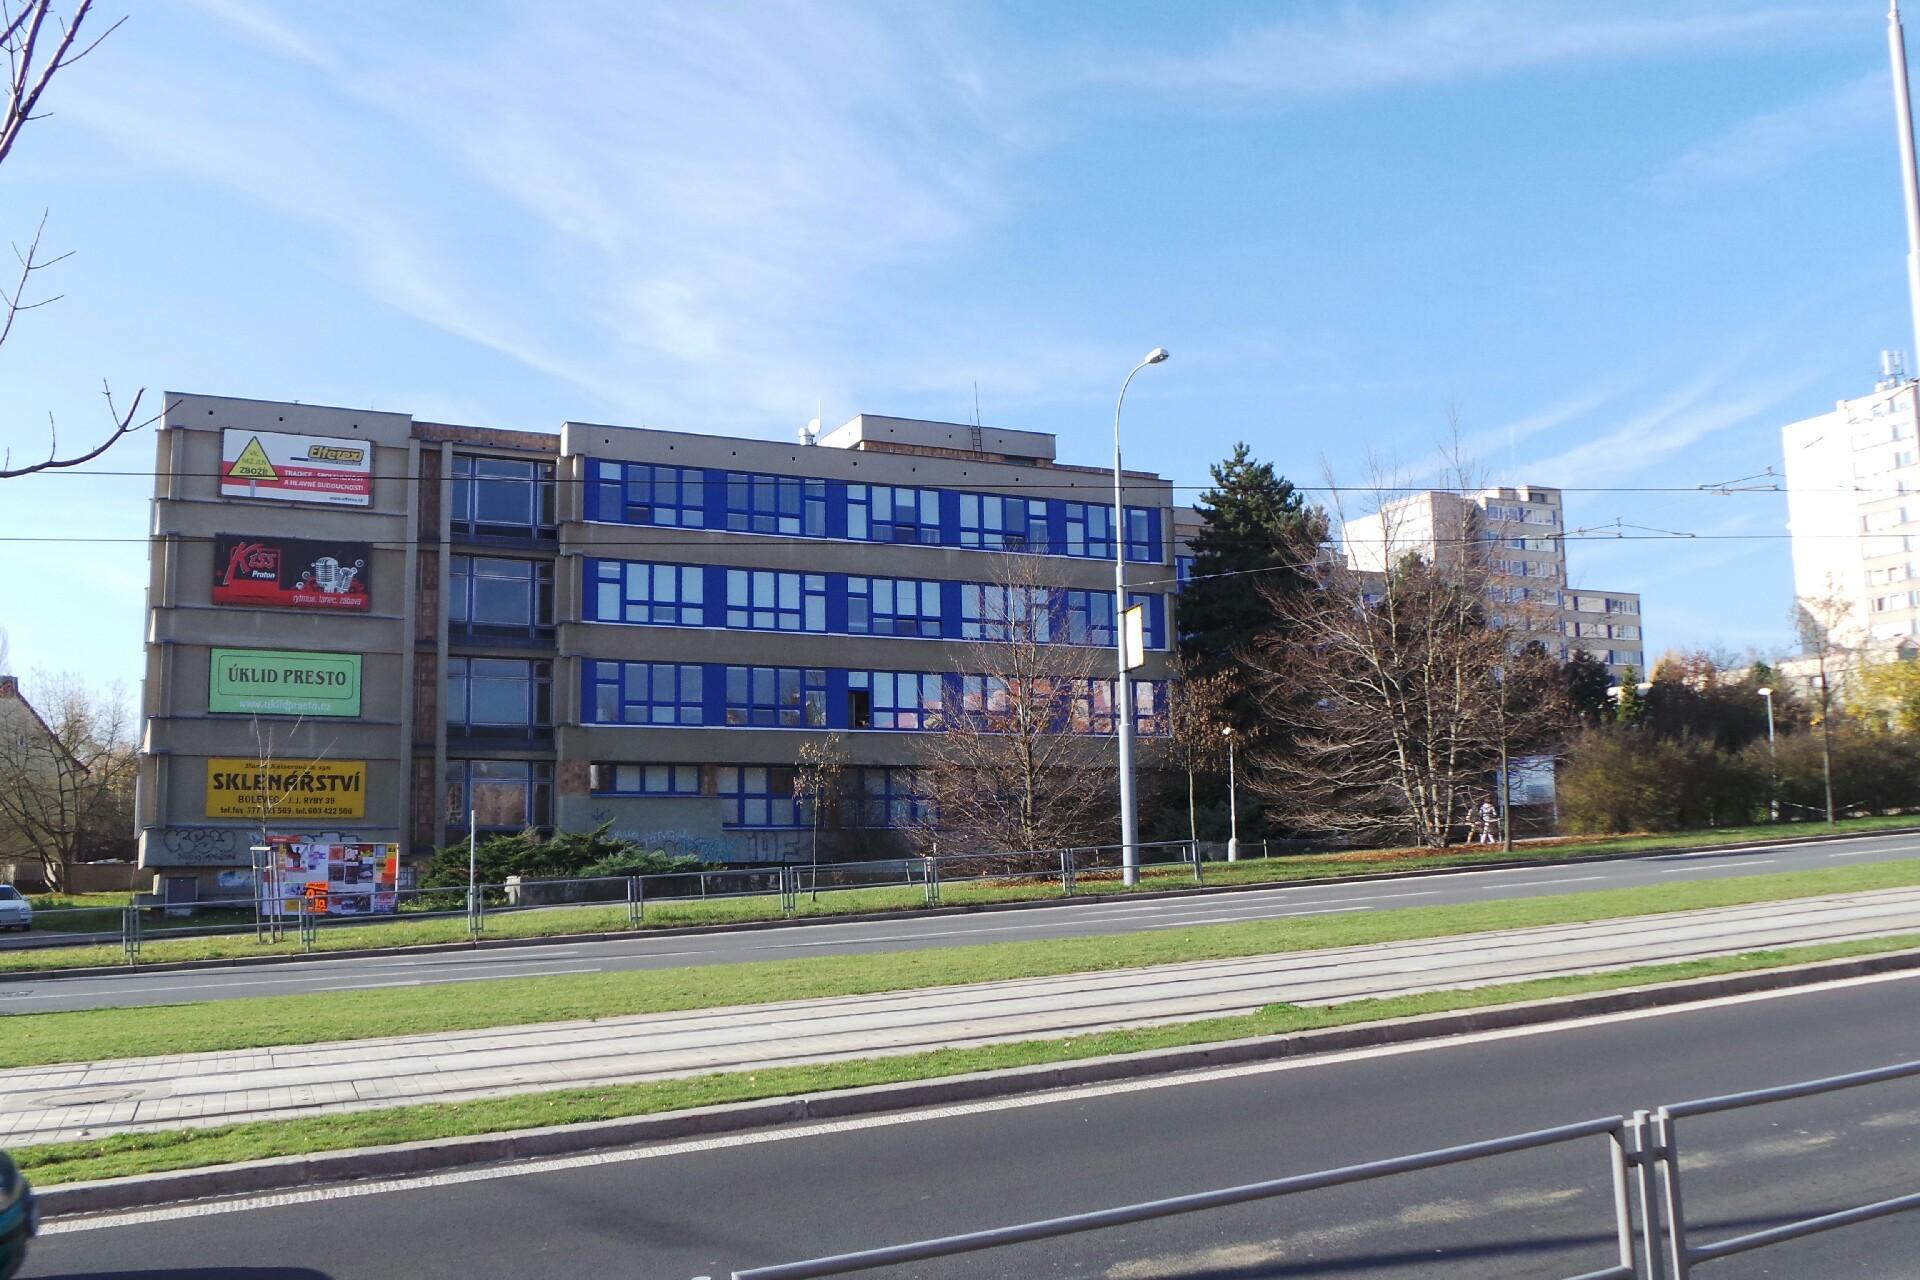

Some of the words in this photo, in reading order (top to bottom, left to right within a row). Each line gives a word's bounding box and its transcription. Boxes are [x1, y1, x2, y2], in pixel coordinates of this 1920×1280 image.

[252, 570, 276, 579] Proton
[228, 664, 278, 682] ÚKLID
[283, 669, 347, 686] PRESTO
[213, 770, 361, 793] SKLENÁŘSTVÍ
[238, 795, 280, 804] BOLEVEC
